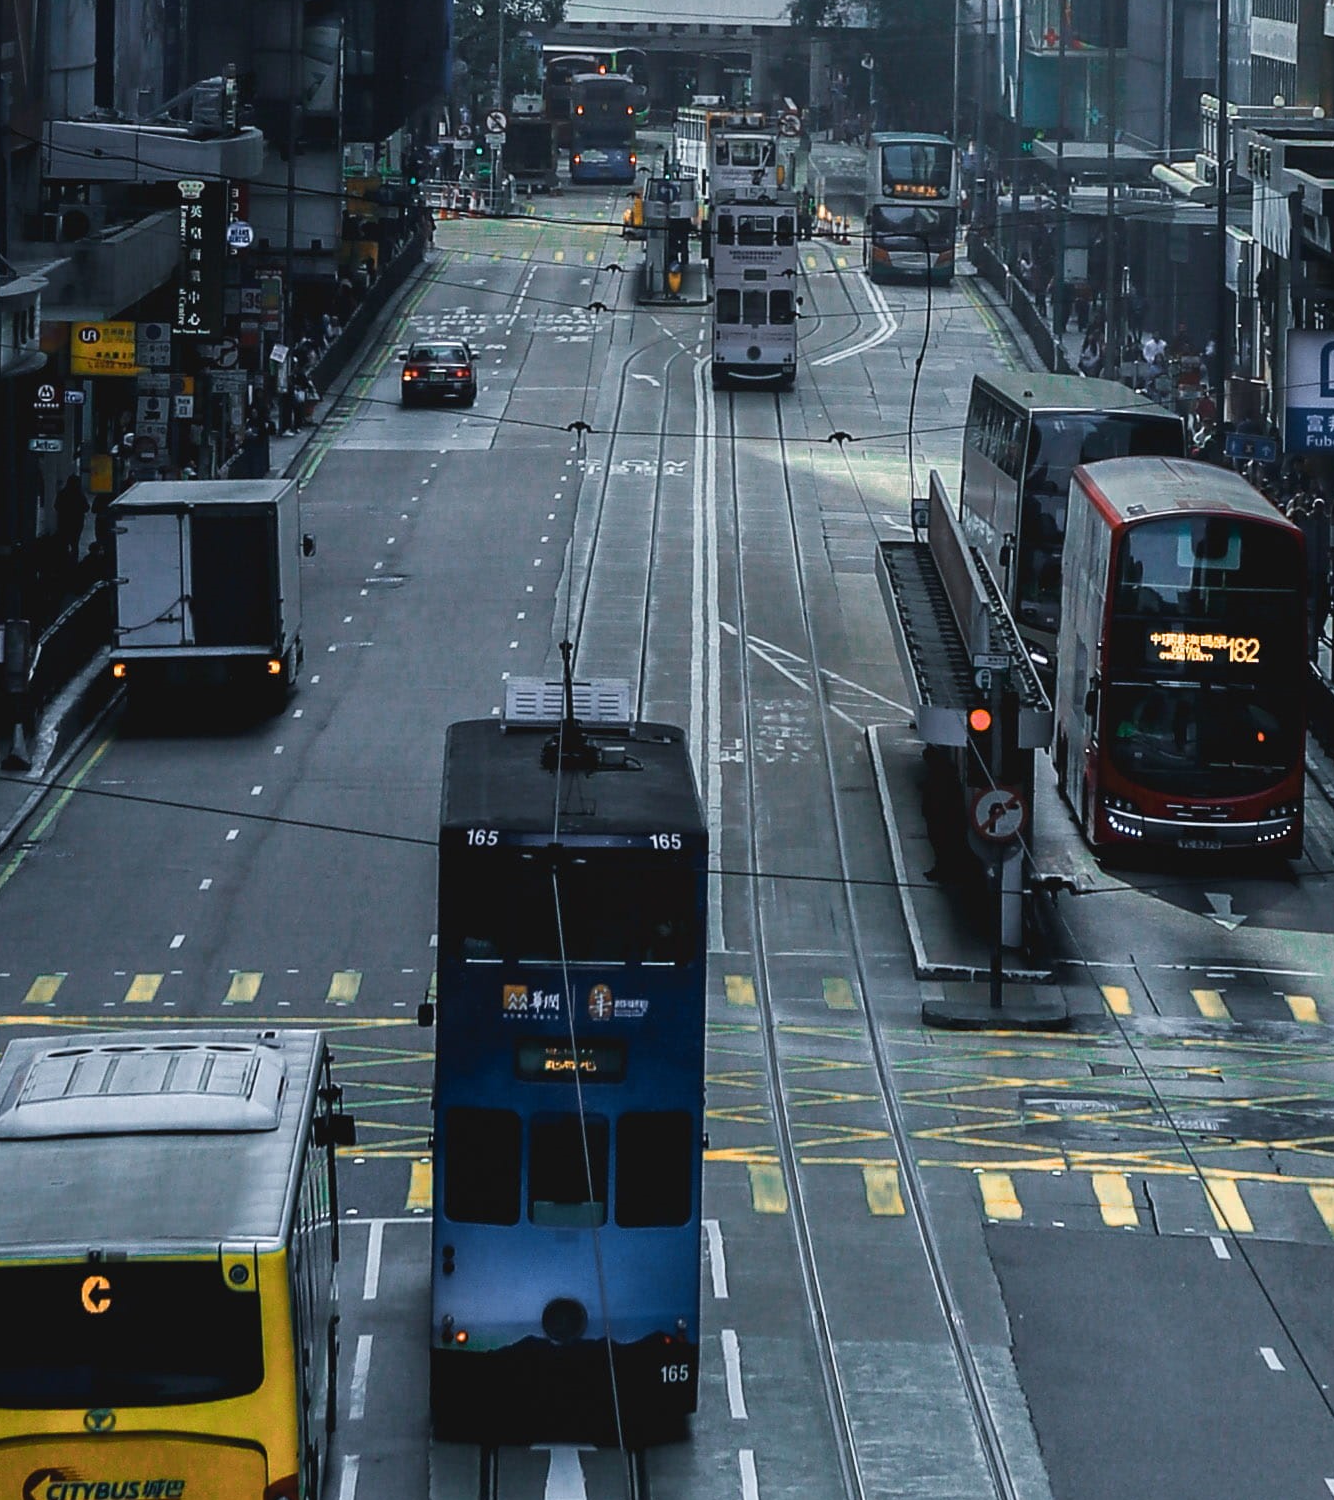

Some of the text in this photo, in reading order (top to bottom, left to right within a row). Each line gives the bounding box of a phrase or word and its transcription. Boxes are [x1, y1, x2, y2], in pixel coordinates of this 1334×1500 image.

[1226, 636, 1261, 664] 182
[465, 829, 500, 847] 165
[648, 831, 682, 851] 165
[659, 1364, 689, 1384] 165
